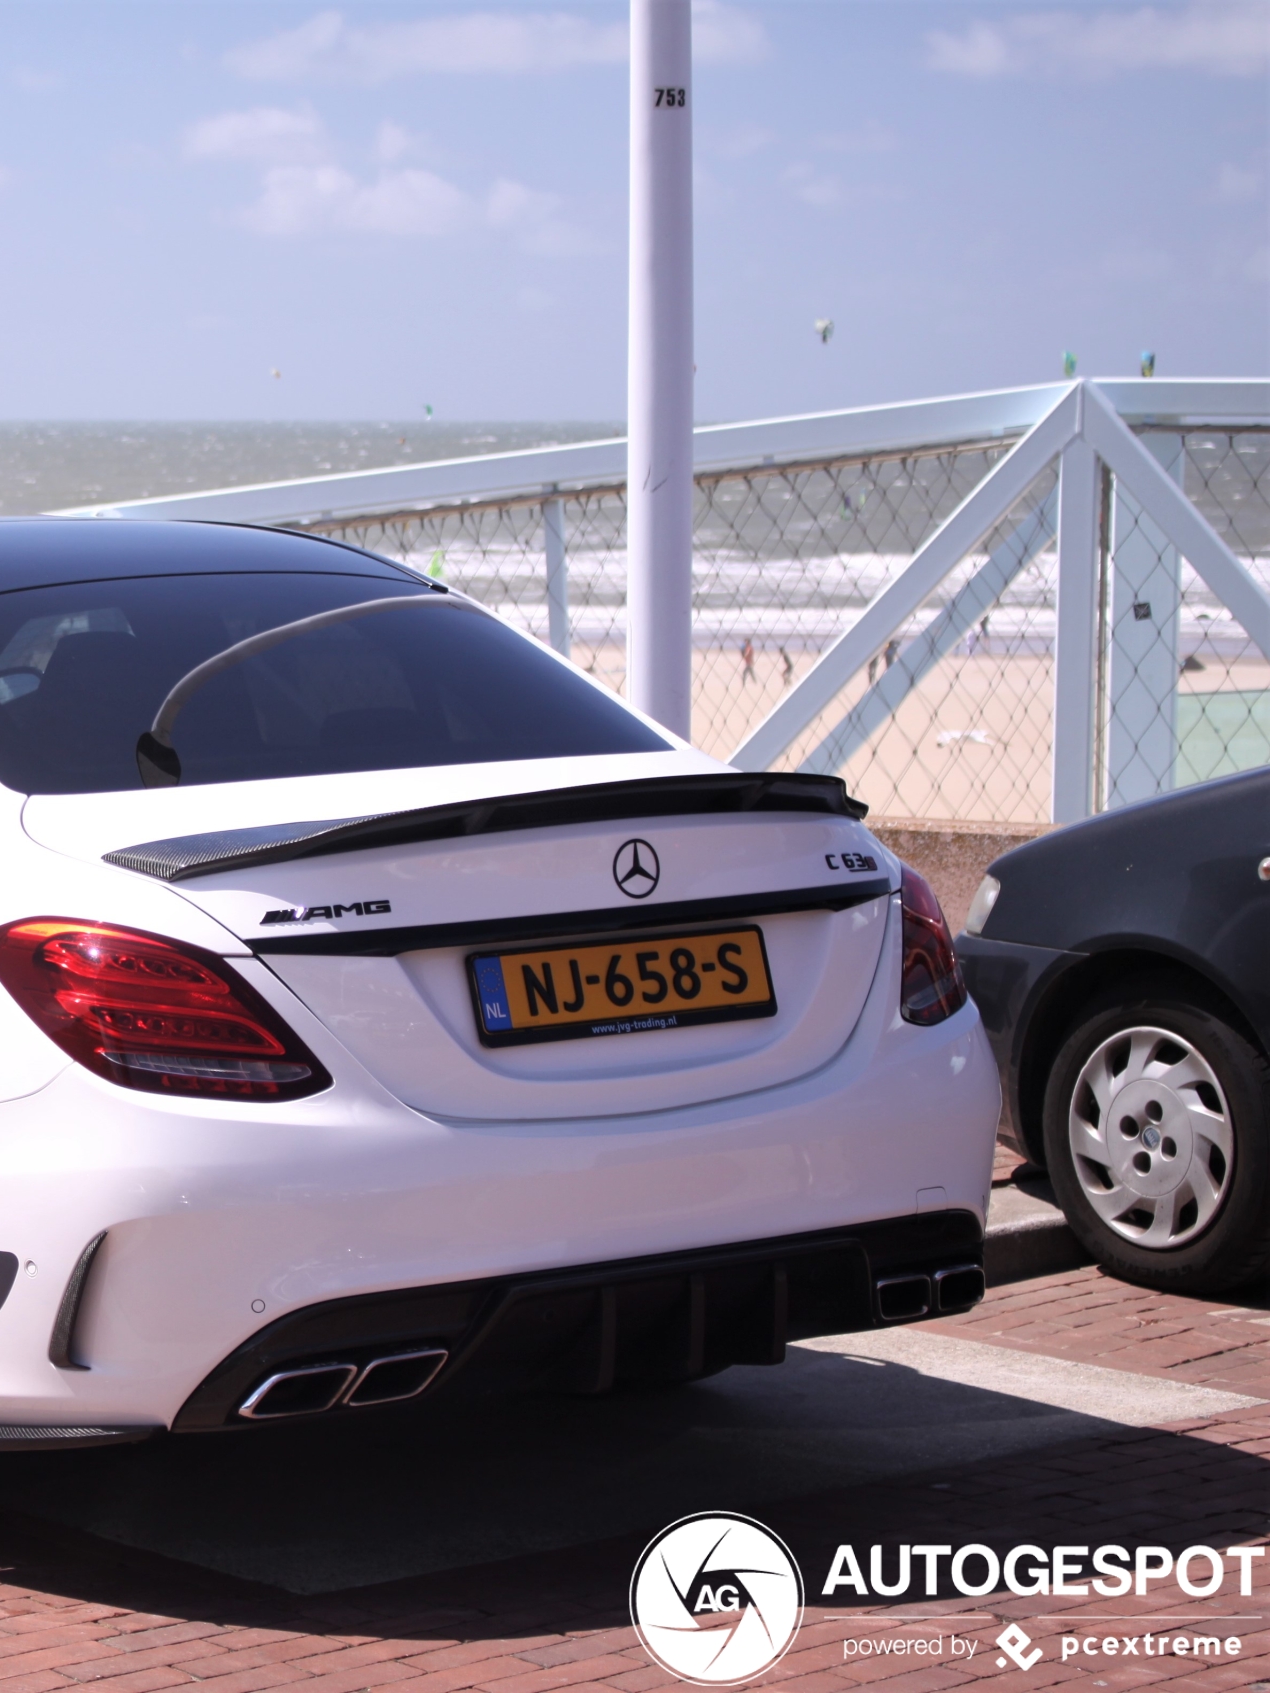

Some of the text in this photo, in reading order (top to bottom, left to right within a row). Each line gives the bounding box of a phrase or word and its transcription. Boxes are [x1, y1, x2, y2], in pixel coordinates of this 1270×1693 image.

[654, 88, 686, 107] 753
[824, 853, 840, 870] C
[302, 900, 392, 921] AMG
[521, 942, 749, 1017] NJ-658-S
[486, 1002, 507, 1020] NL
[591, 1015, 678, 1034] www.jvg-trading.nl
